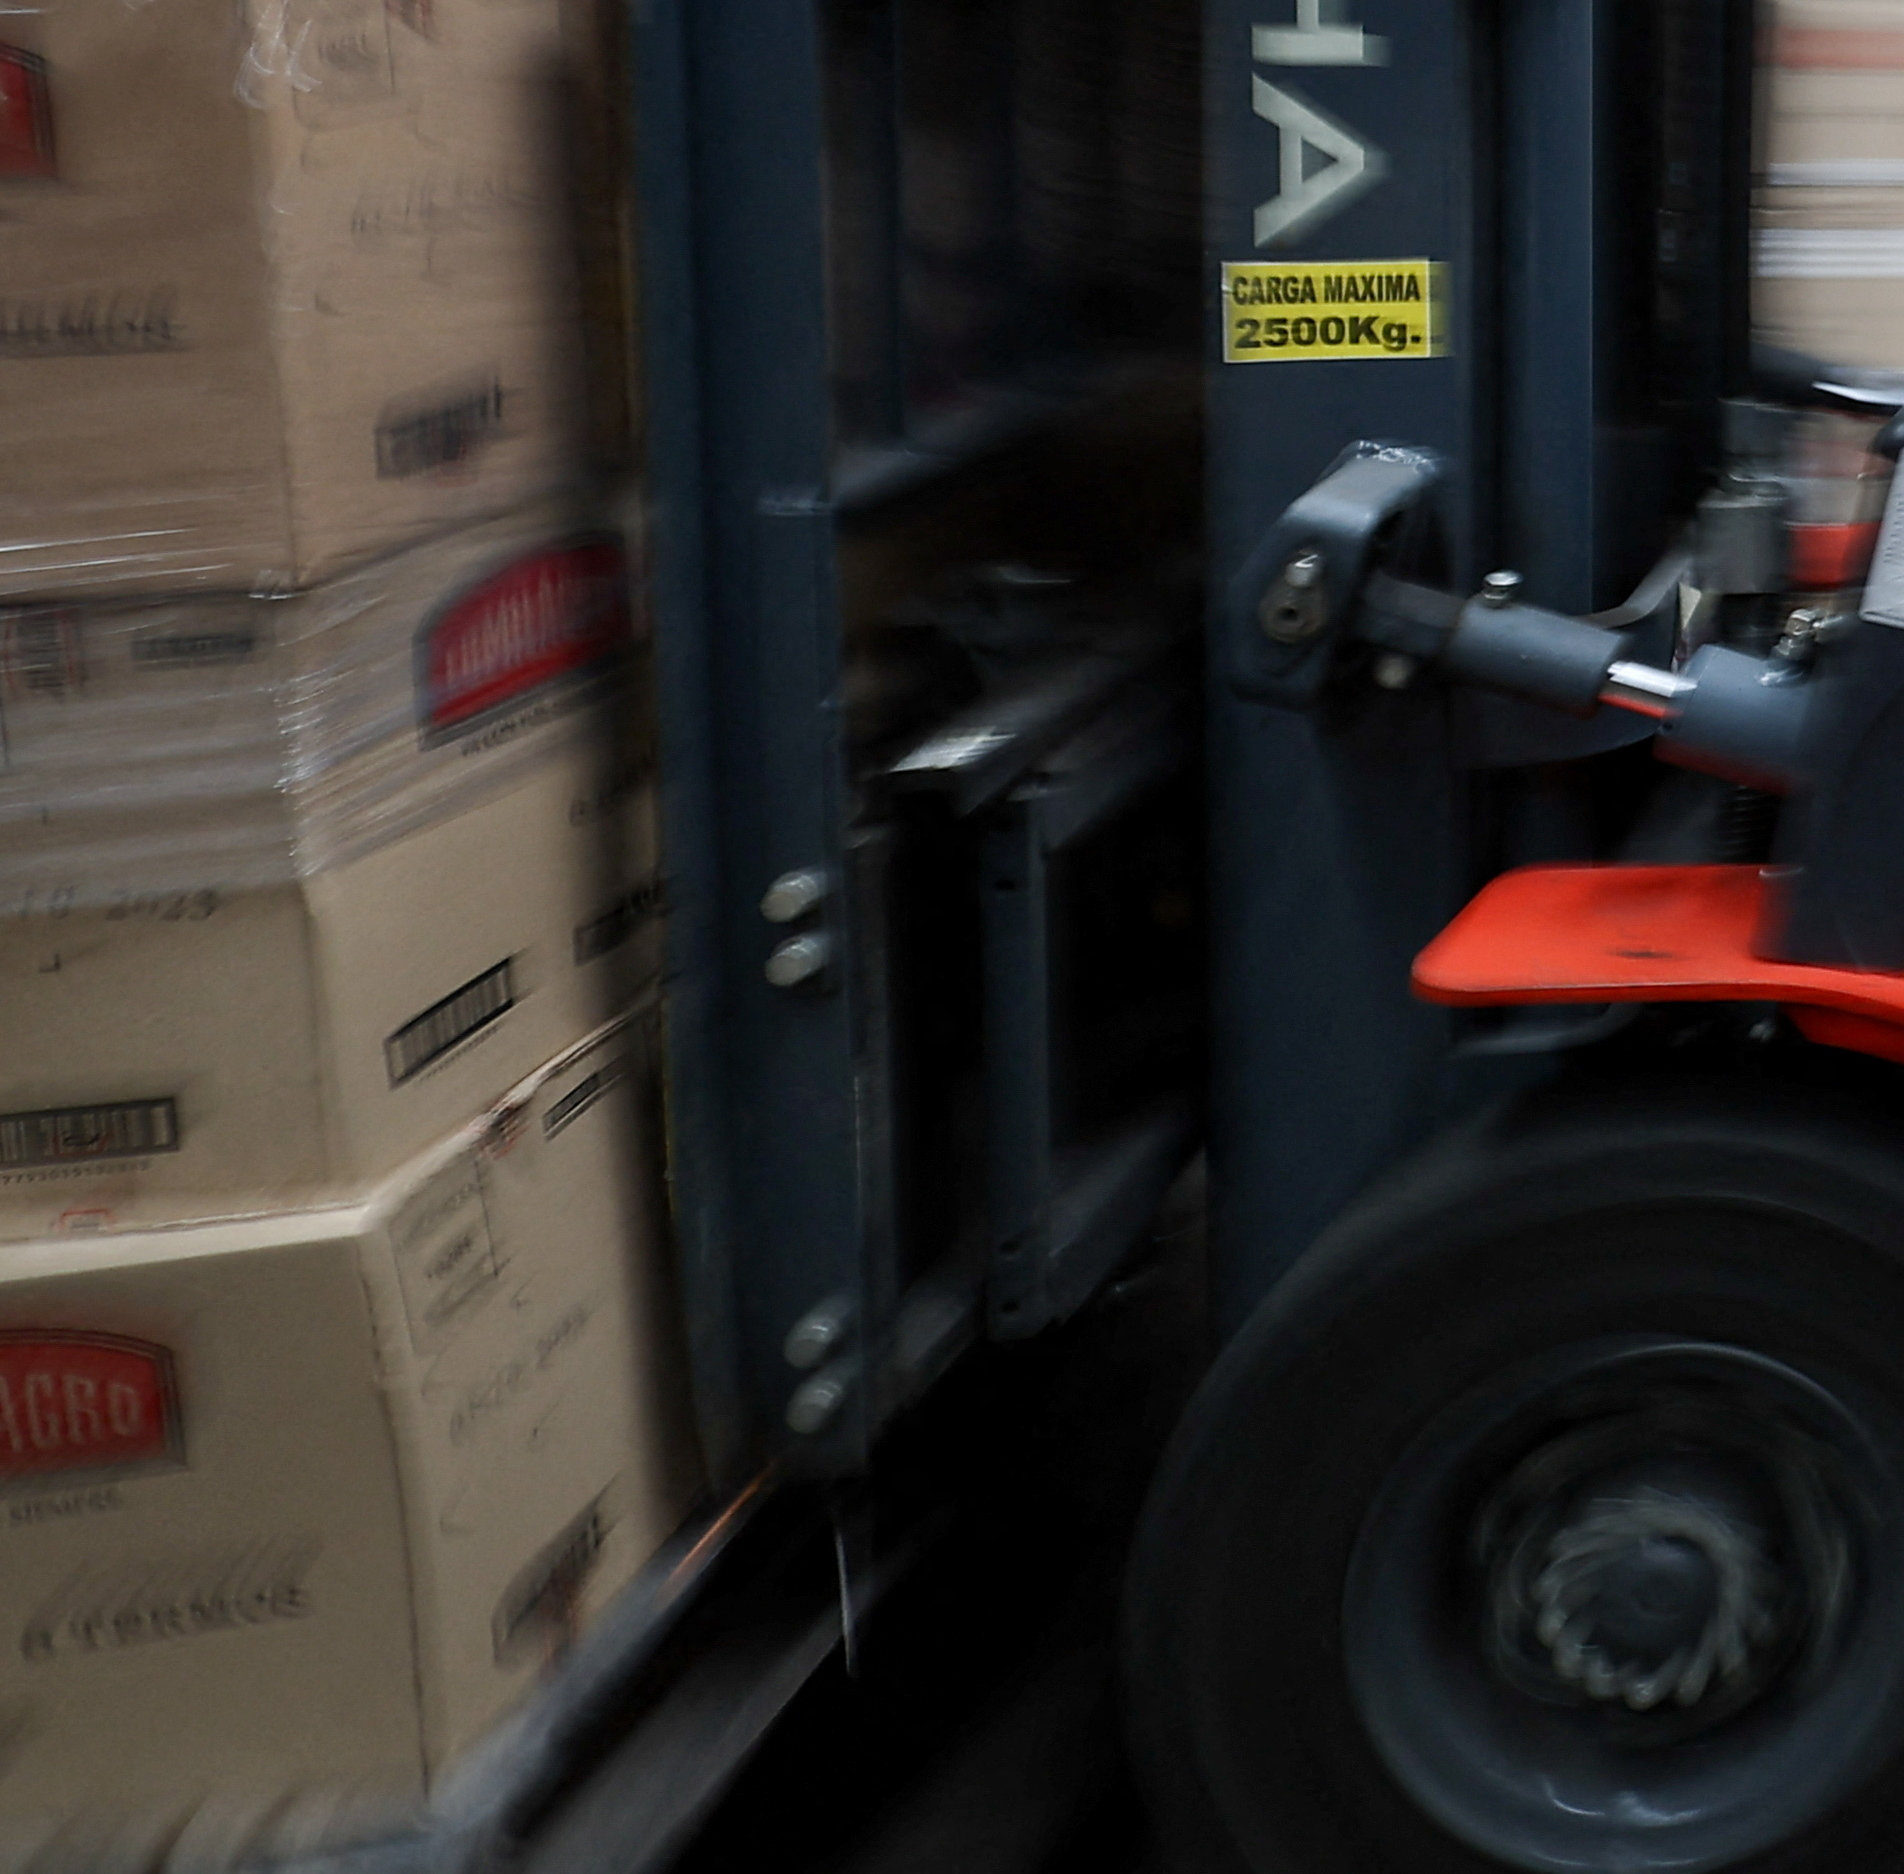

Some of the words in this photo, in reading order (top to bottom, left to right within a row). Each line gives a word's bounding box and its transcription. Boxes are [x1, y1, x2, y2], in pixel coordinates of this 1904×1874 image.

[1232, 275, 1317, 305] CARGA
[1323, 273, 1421, 304] MAXIMA
[1234, 315, 1423, 352] 2500Kg.
